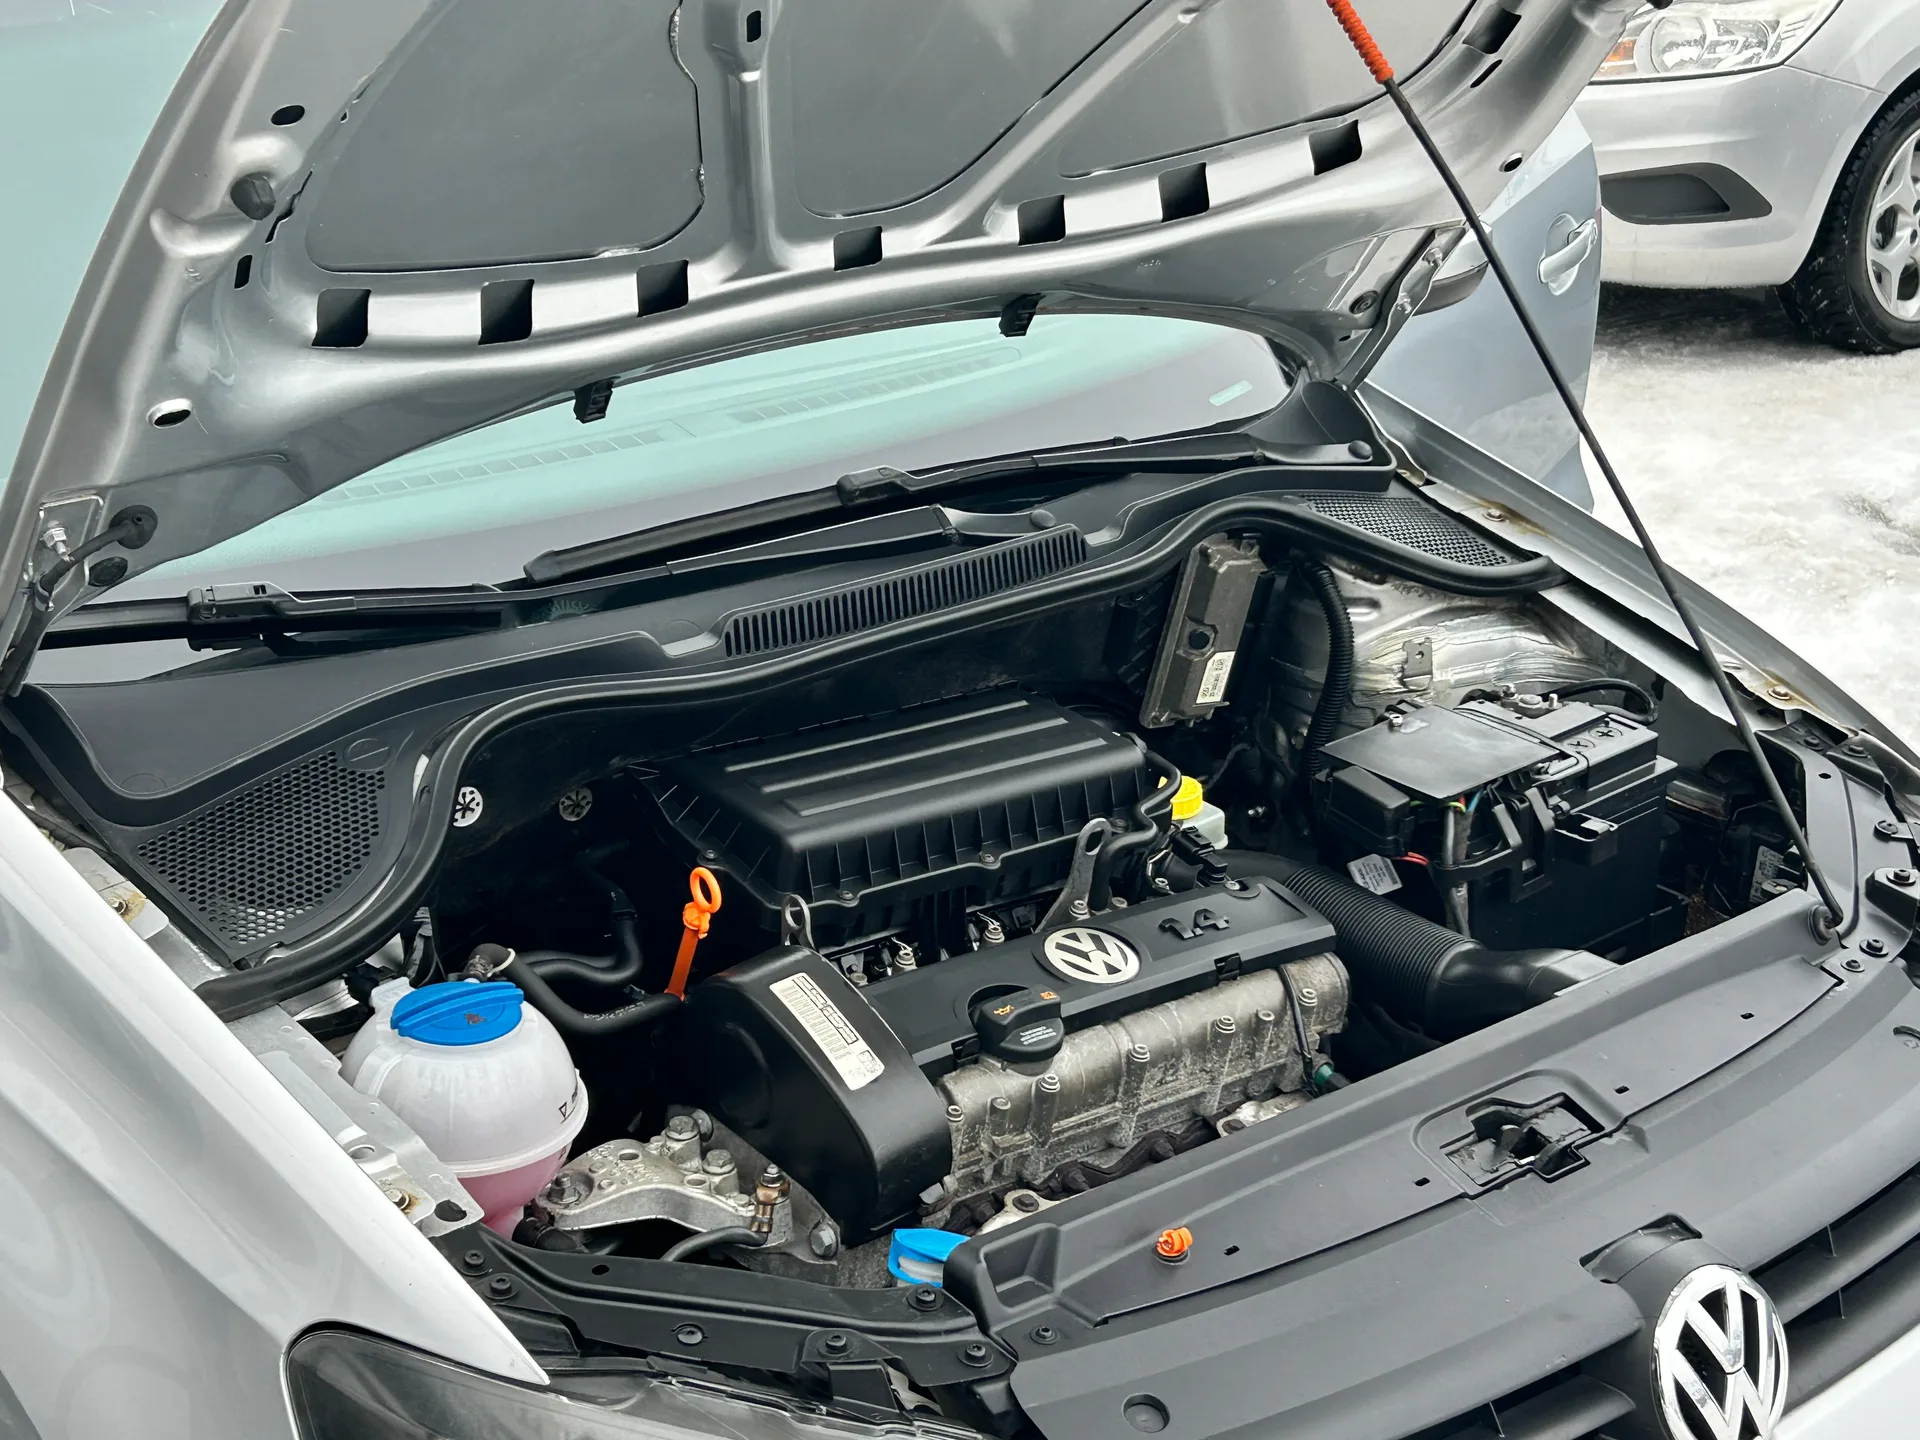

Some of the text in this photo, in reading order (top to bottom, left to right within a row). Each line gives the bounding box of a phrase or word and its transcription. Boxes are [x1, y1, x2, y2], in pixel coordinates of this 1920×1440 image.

[1158, 908, 1230, 941] 1.4
[1045, 928, 1139, 983] VW
[1655, 1266, 1787, 1440] VW
